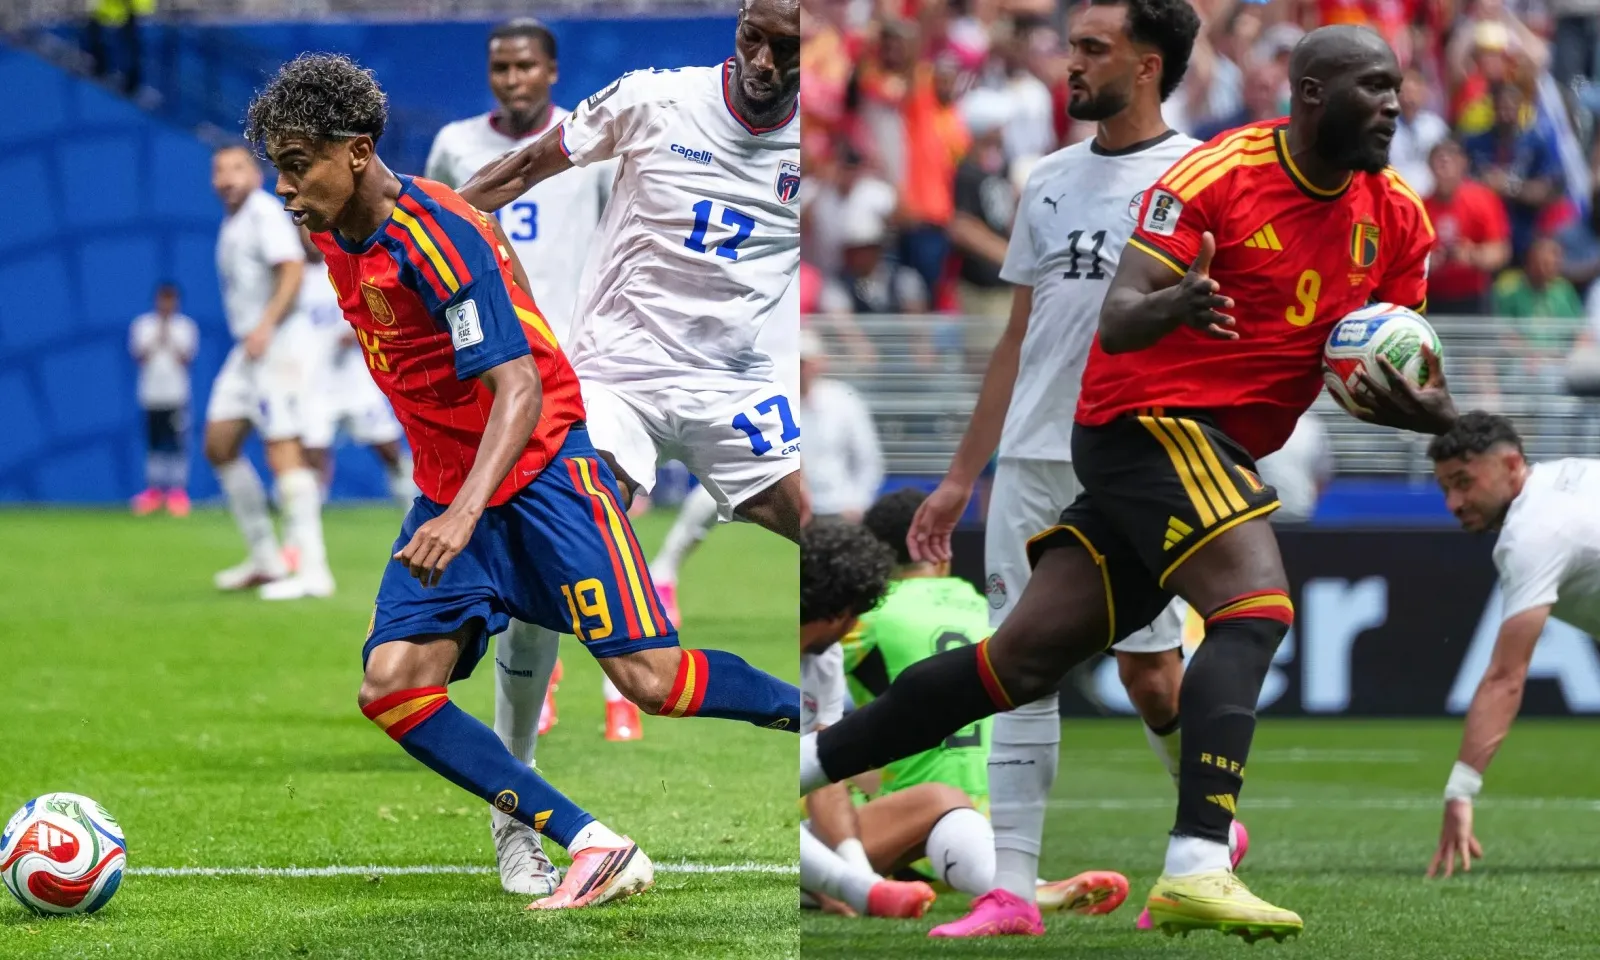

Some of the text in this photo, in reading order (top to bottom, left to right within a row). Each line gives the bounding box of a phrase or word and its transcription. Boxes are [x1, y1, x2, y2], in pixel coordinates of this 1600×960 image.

[670, 143, 713, 163] capelli
[494, 203, 538, 241] 3
[683, 199, 756, 260] 17
[1063, 229, 1107, 280] 11
[1285, 269, 1321, 327] 9
[731, 394, 800, 457] 17
[560, 577, 613, 641] 19
